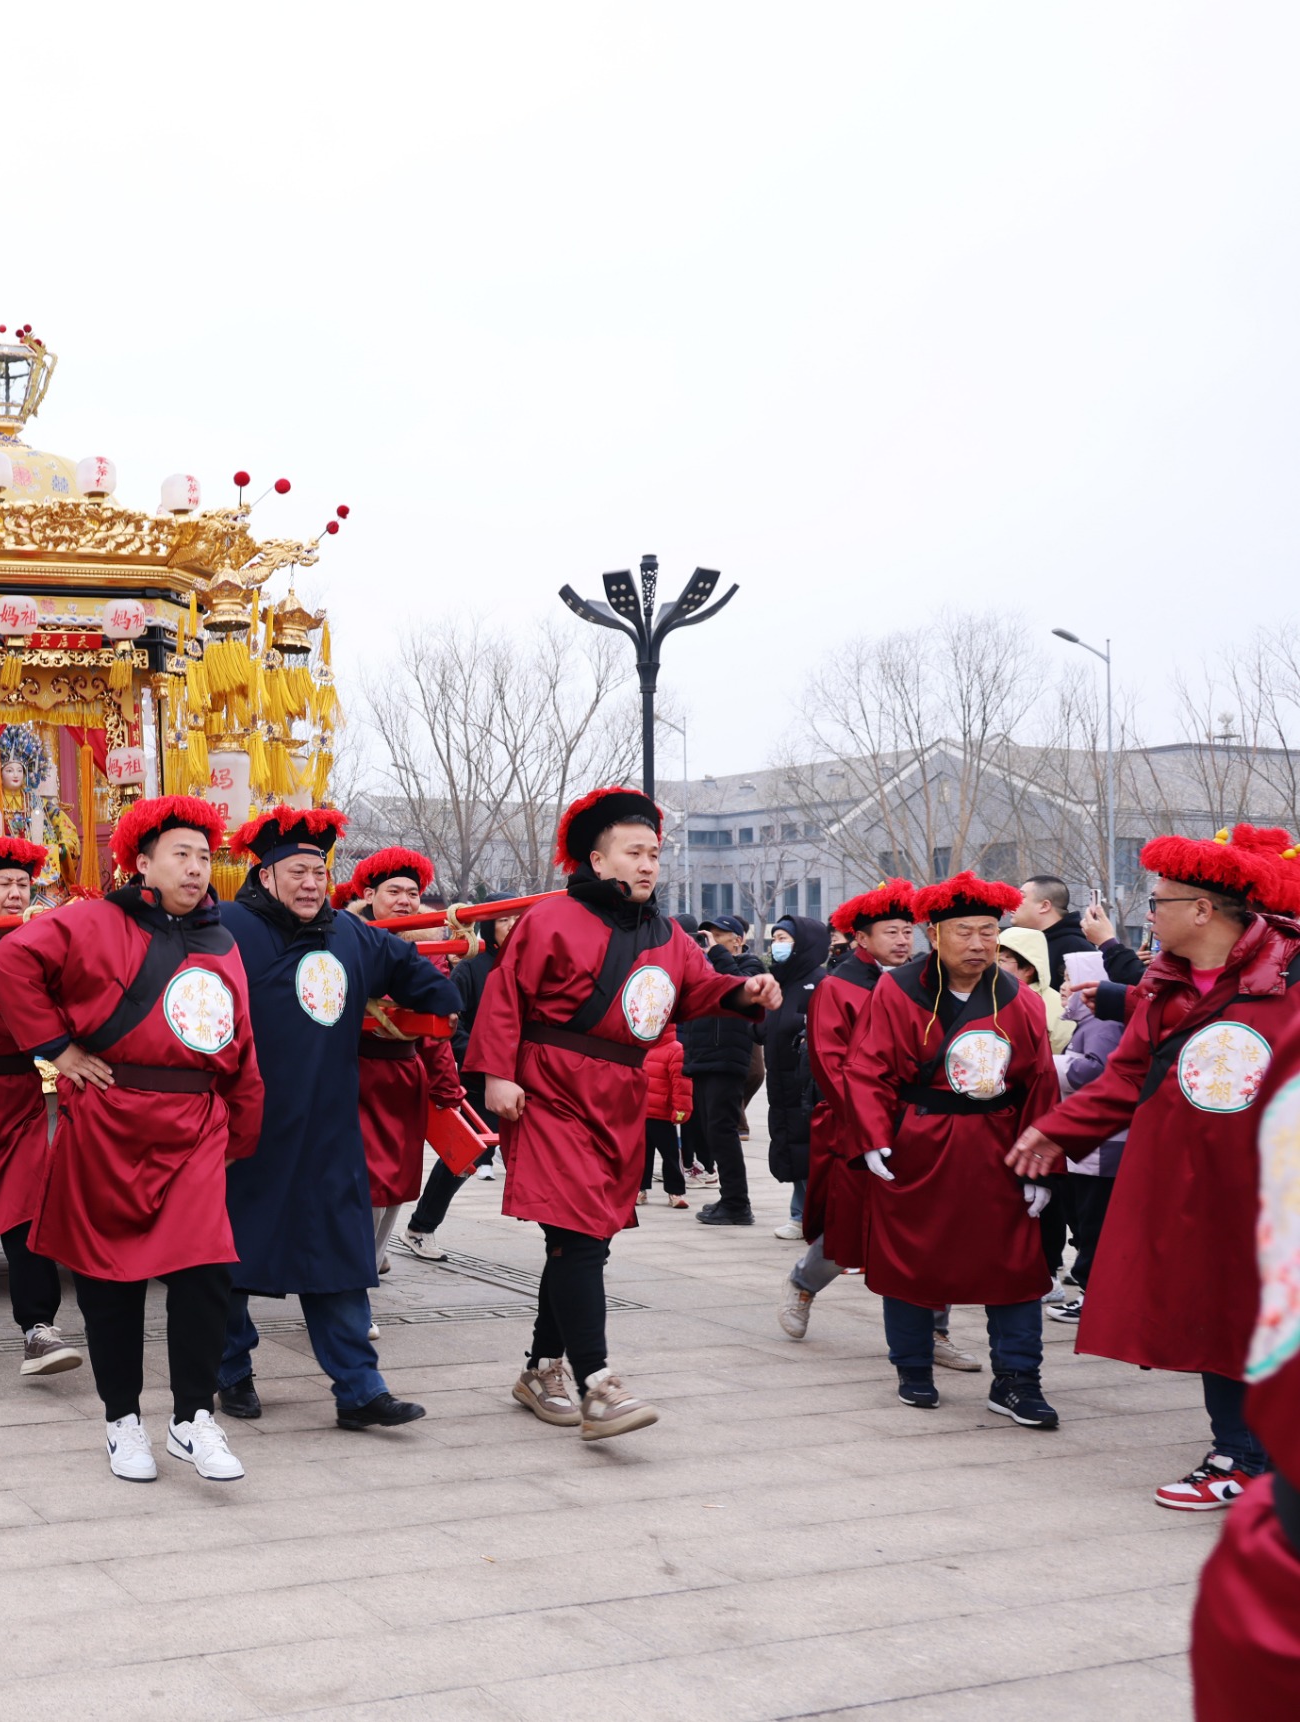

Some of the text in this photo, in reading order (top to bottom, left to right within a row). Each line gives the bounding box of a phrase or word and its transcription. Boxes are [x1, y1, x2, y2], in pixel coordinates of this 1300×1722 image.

[0, 603, 37, 627] 妈祖
[111, 608, 145, 630] 妈祖
[108, 755, 143, 778] 妈祖
[1206, 1028, 1236, 1103] 東茶棚
